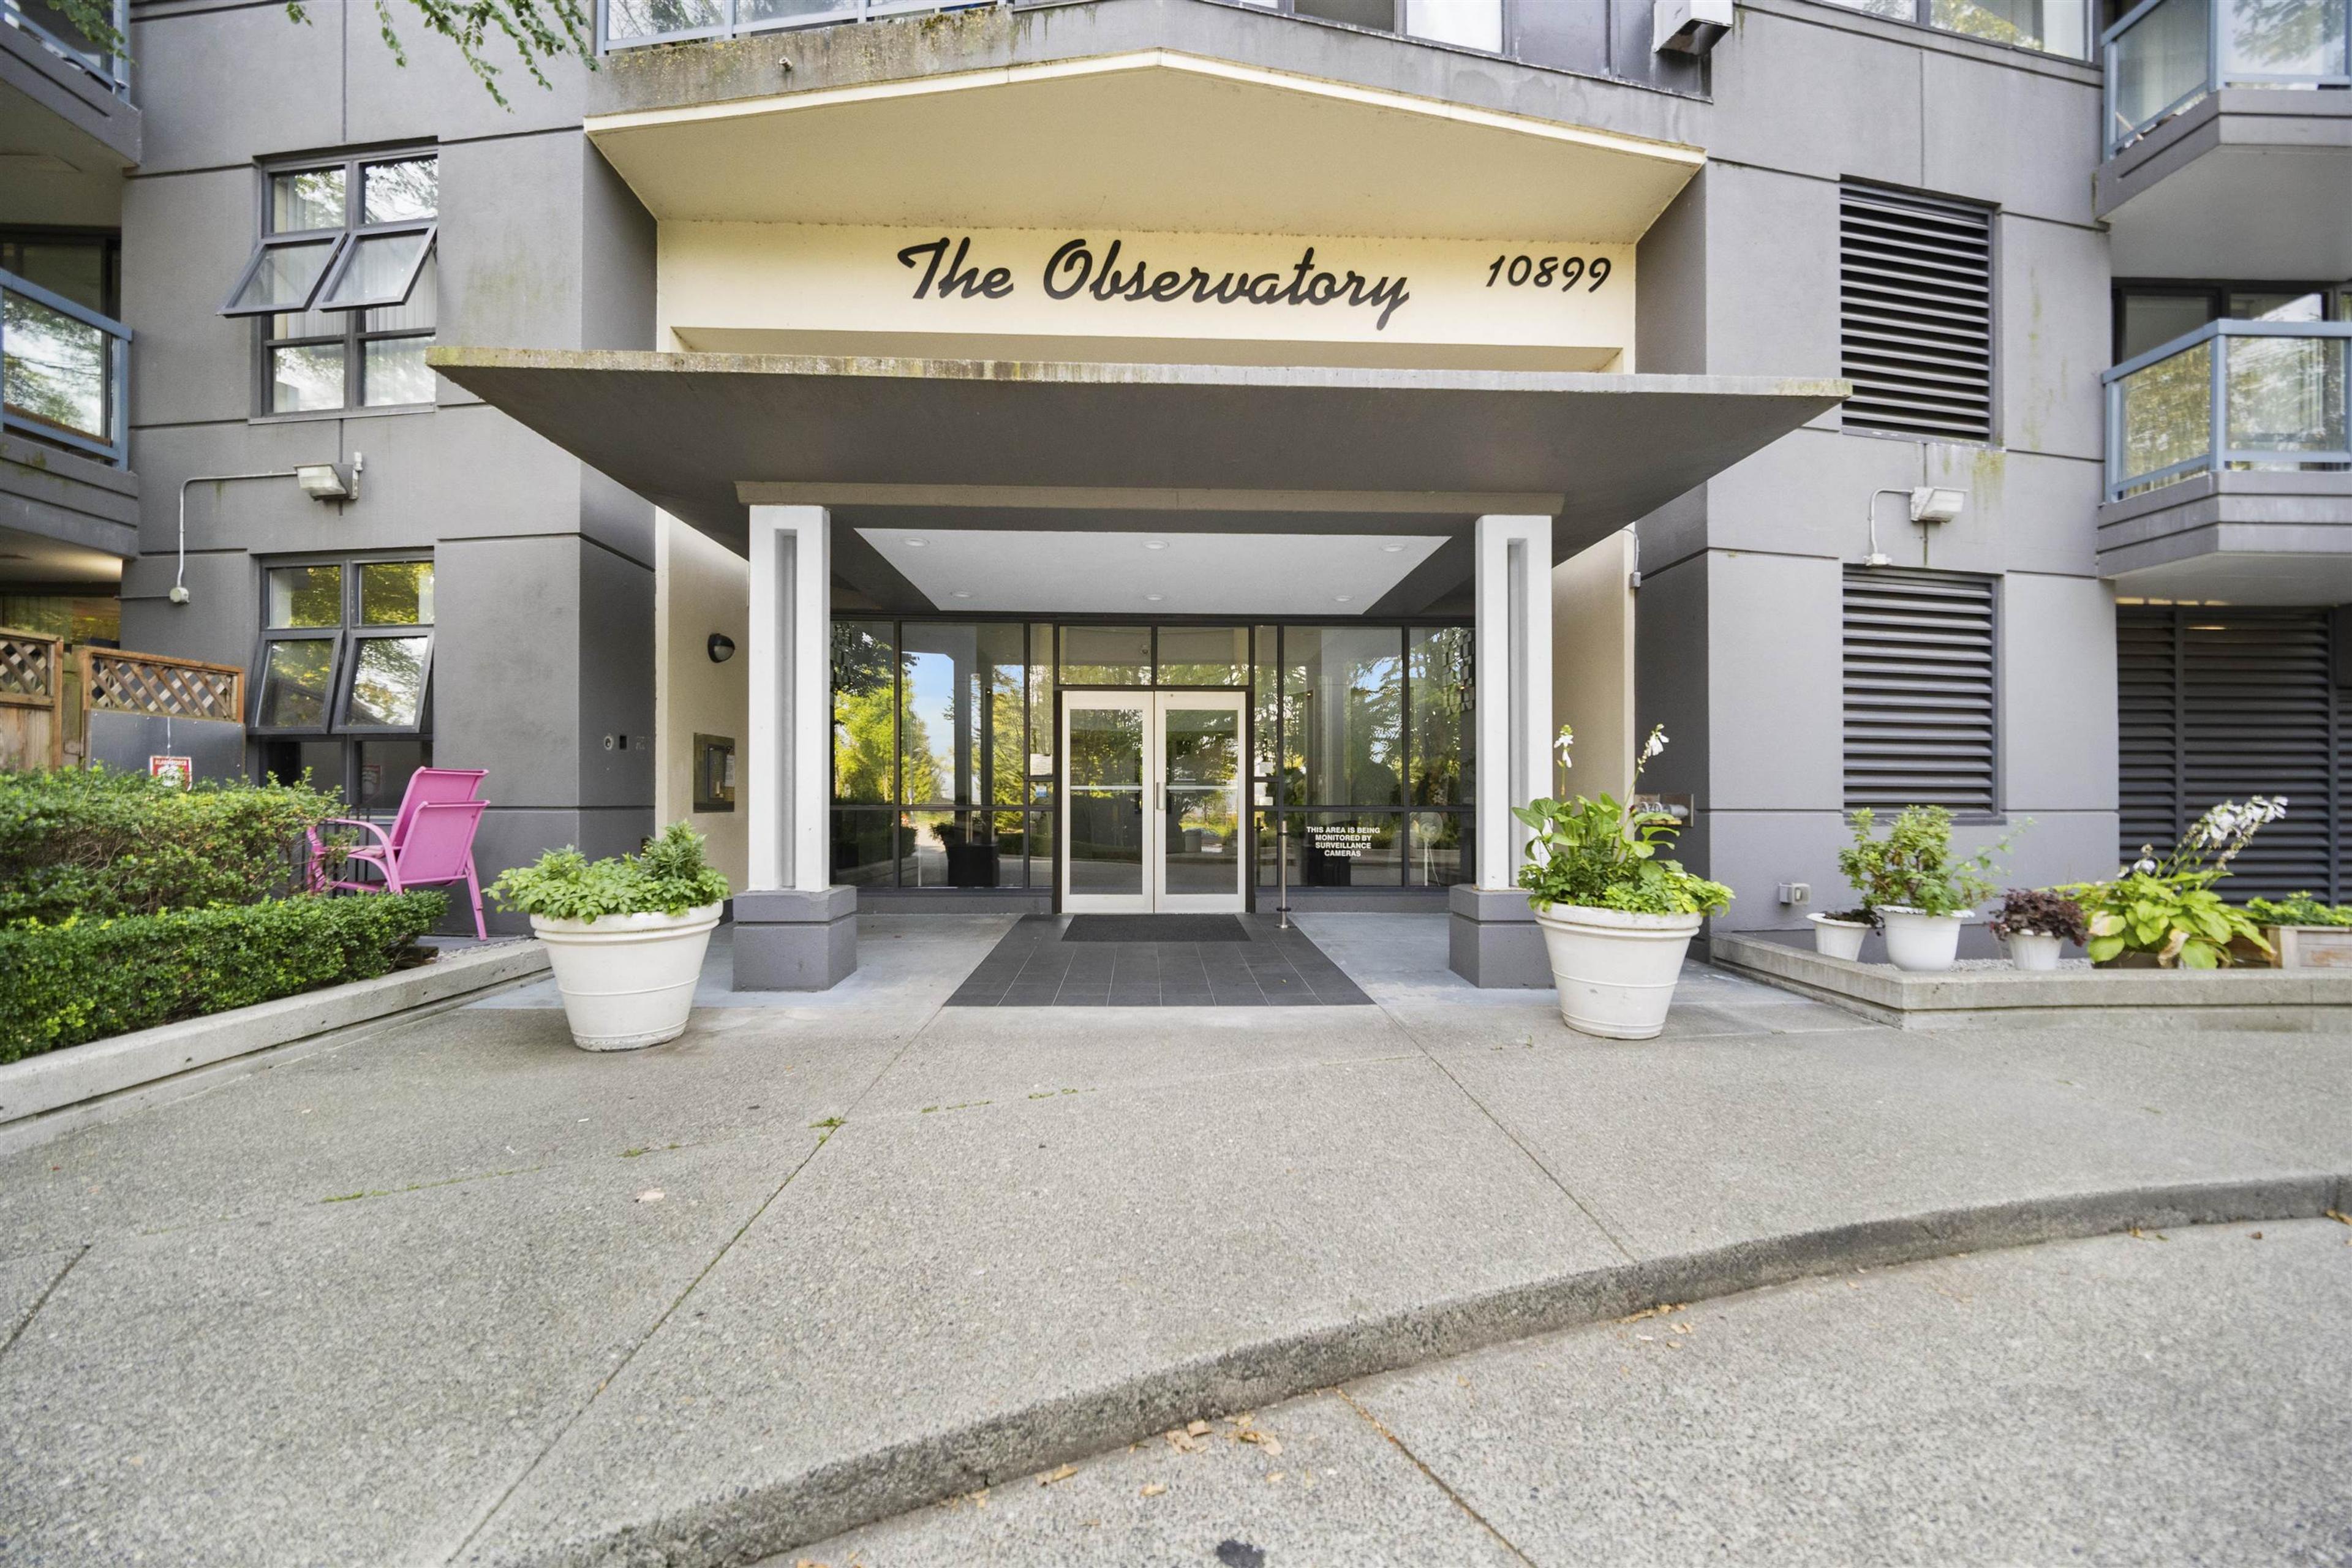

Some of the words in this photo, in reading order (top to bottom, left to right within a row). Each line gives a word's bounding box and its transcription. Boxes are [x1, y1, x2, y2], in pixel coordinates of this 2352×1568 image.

[897, 236, 1014, 300] The
[1043, 238, 1410, 332] Observatory
[1487, 255, 1611, 293] 10899
